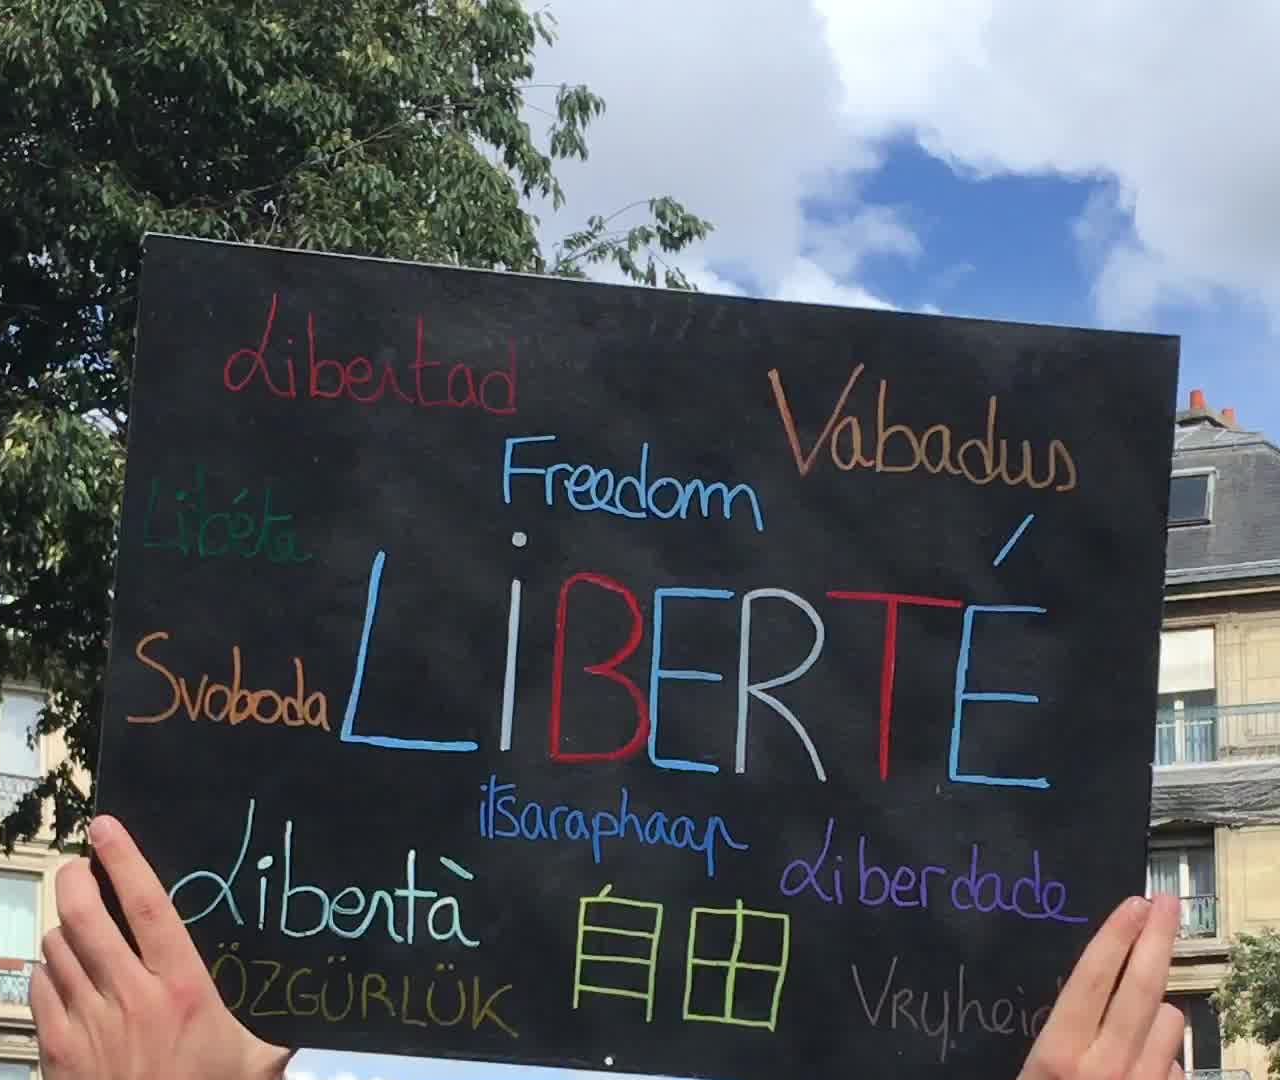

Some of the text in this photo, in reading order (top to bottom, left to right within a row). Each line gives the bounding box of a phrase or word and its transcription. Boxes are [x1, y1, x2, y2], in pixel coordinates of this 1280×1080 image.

[223, 292, 518, 415] Libertad
[503, 434, 765, 533] Freedom
[767, 362, 1078, 492] Vabadus
[127, 631, 332, 732] Svoboda
[168, 798, 481, 948] Libertà
[779, 817, 1089, 924] Liberdade
[211, 941, 521, 1039] ÖZGÜRLÜK
[572, 883, 790, 1033] 自由
